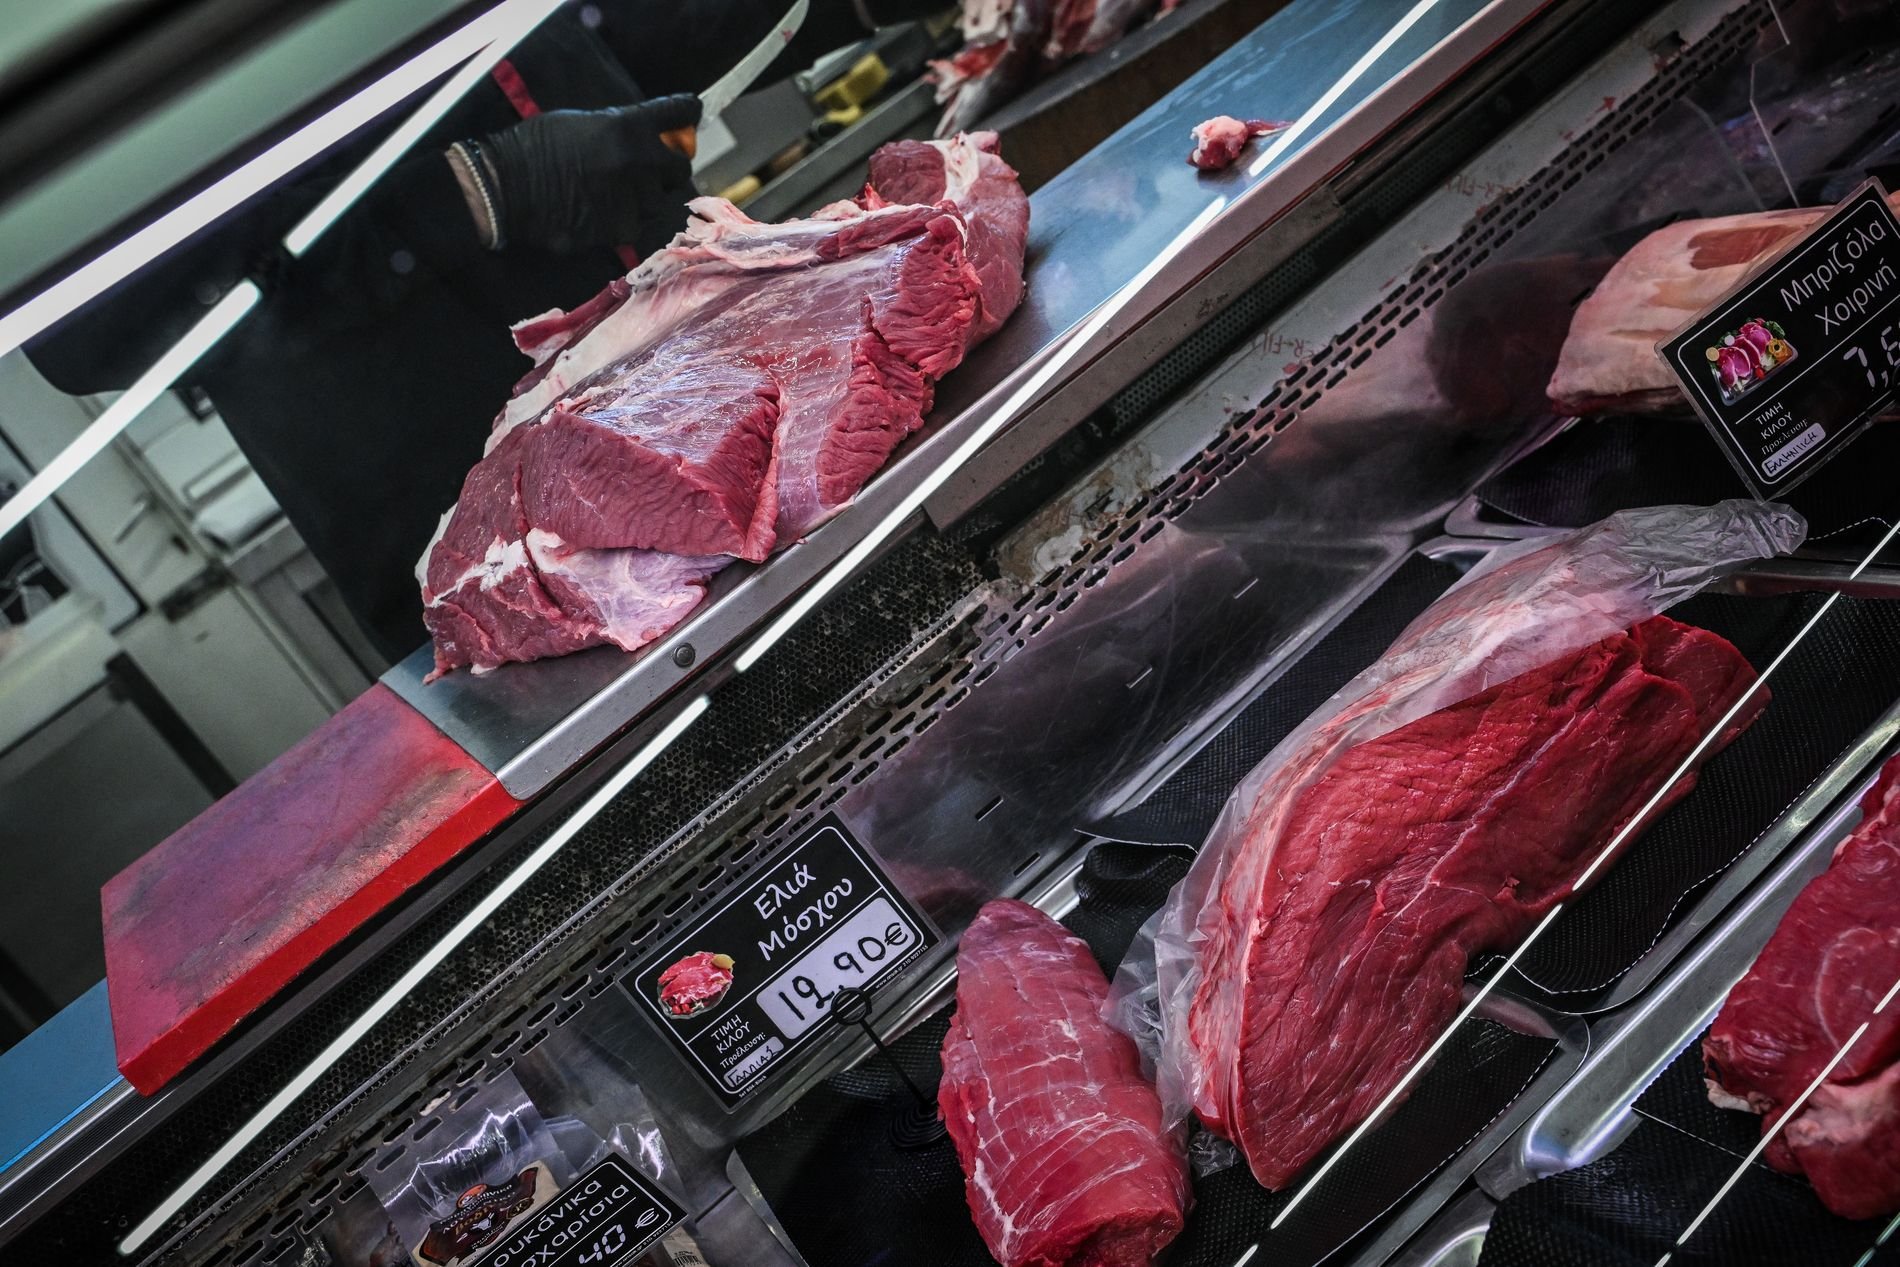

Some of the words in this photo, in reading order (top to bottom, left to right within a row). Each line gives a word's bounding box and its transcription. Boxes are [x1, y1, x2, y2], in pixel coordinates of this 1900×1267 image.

[1780, 220, 1886, 312] Μπριζόλα
[1814, 257, 1897, 336] Χοιρινή
[1755, 402, 1784, 425] ΤΙΜΗ
[1760, 411, 1793, 440] ΚΙΛΟΥ
[753, 862, 817, 920] Ελιά
[757, 878, 853, 961] Μόσχου
[710, 1014, 742, 1041] ΤΙΜΗ
[716, 1021, 751, 1054] ΚΙΛΟΥ
[634, 1207, 660, 1229] €
